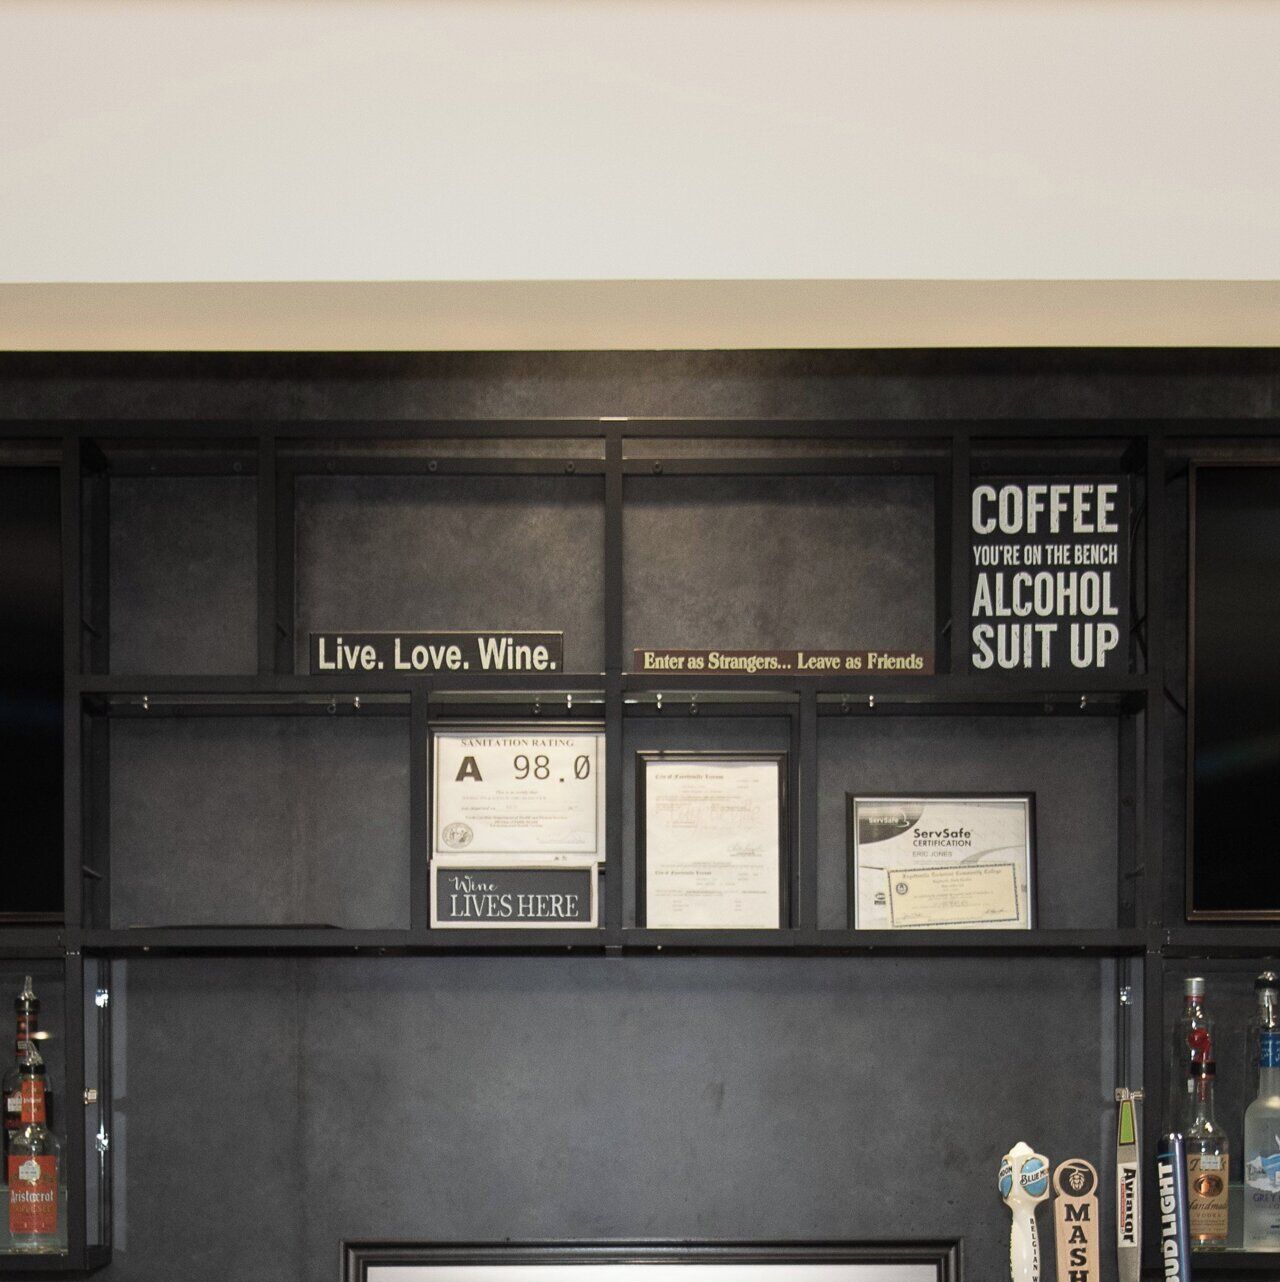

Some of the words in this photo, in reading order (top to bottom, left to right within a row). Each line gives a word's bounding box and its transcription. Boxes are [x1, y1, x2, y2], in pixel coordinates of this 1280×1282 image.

[972, 484, 1119, 535] COFFEE
[973, 544, 1021, 566] YOU'RE
[1023, 544, 1042, 566] ON
[1045, 544, 1071, 566] THE
[1074, 544, 1118, 566] BENCH
[972, 571, 1119, 617] ALCOHOL
[319, 637, 384, 670] Live.
[394, 637, 469, 670] Love.
[477, 637, 556, 670] Wine.
[972, 623, 1058, 669] SUIT
[1070, 623, 1120, 668] UP
[644, 652, 685, 669] Enter
[687, 655, 704, 669] as
[708, 652, 792, 673] Strangers...
[797, 652, 840, 669] Leave
[845, 655, 862, 669] as
[867, 652, 924, 669] Friends
[461, 739, 531, 748] SANITATION
[532, 739, 574, 748] RATING
[455, 756, 483, 782] A
[913, 828, 971, 839] ServSafe
[913, 839, 971, 847] CERTIFICATION
[449, 875, 498, 893] Wine
[450, 894, 513, 918] LIVES
[517, 894, 579, 918] HERE
[1020, 1170, 1040, 1186] BLUE
[1123, 1168, 1137, 1243] Aviator
[1158, 1162, 1177, 1238] LIGHT
[1029, 1218, 1039, 1271] BELGIAN
